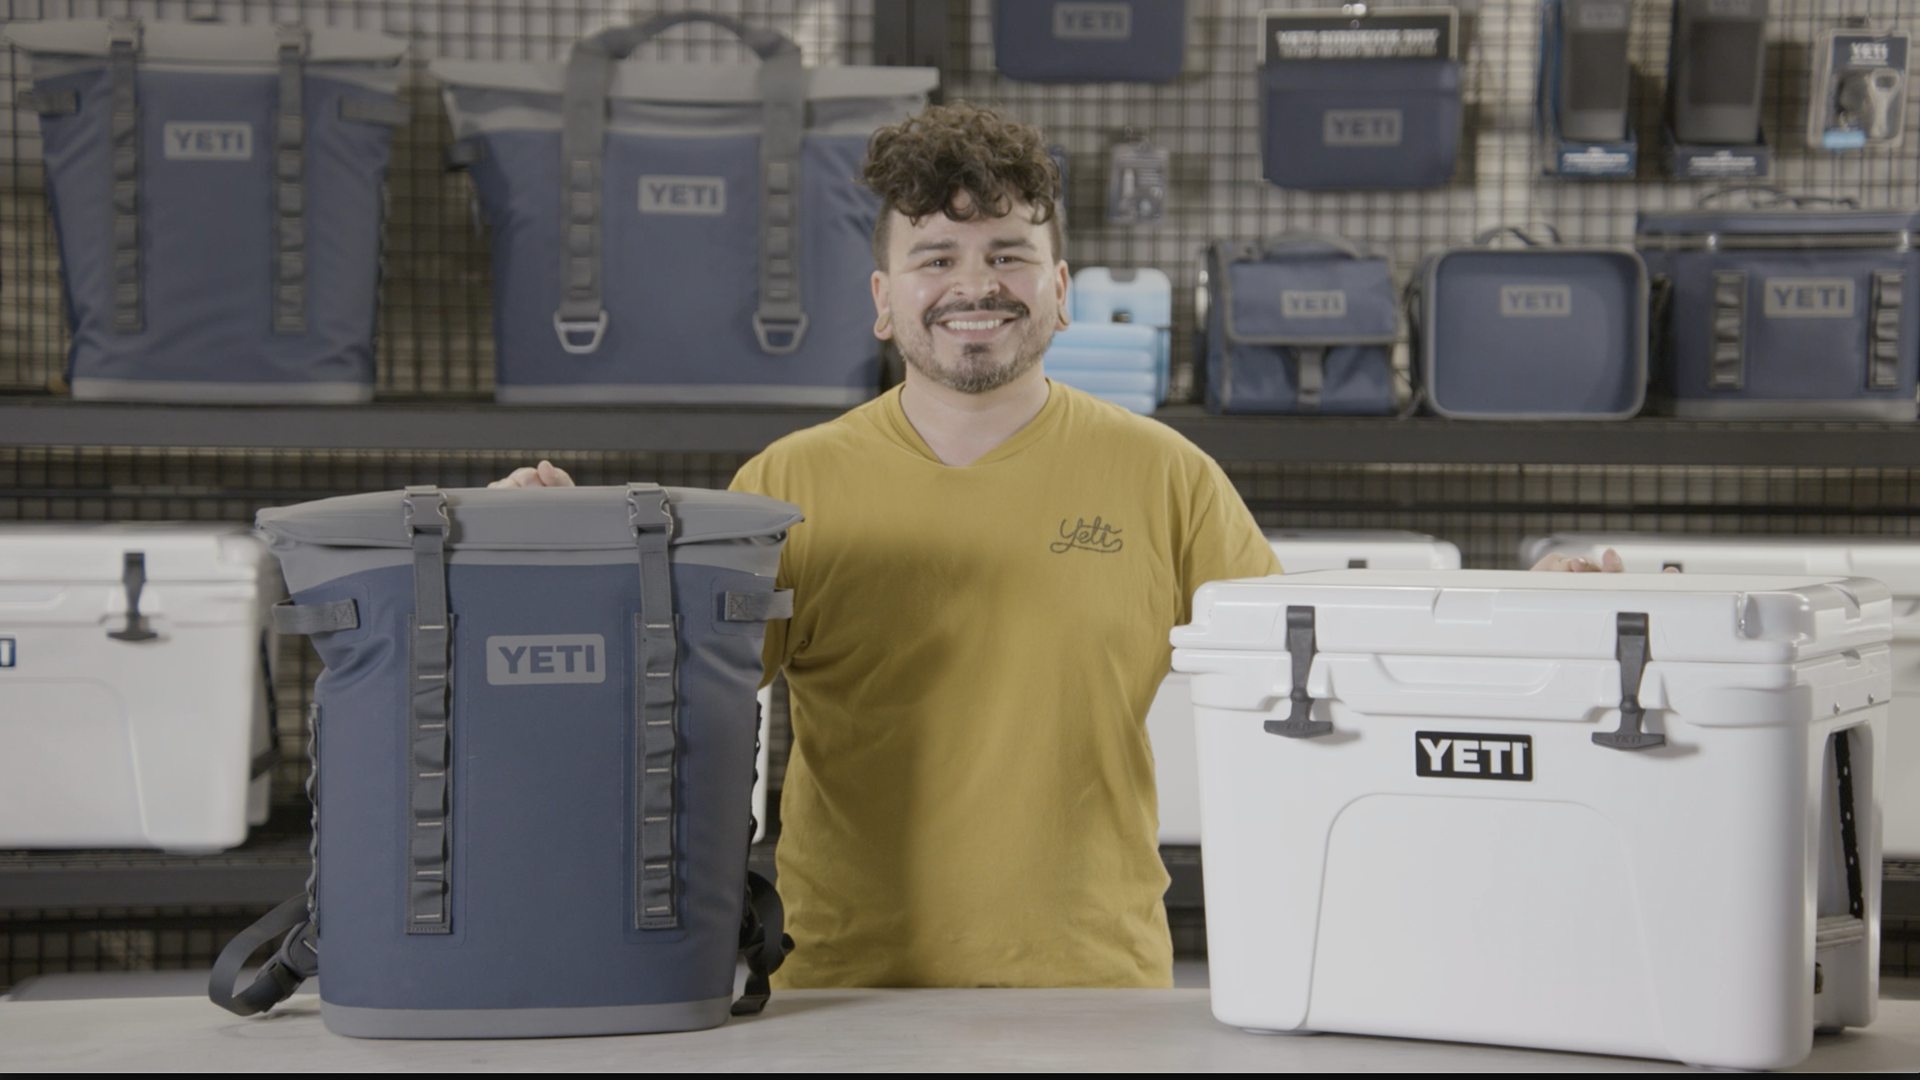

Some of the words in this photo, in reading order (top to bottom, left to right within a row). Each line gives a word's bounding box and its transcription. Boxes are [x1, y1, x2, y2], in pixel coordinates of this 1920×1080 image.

[1331, 116, 1396, 137] YETI
[172, 129, 244, 152] YETI
[647, 183, 718, 206] YETI
[1288, 296, 1340, 311] YETI
[1507, 291, 1563, 310] YETI
[1772, 285, 1846, 309] YETI
[1050, 516, 1123, 553] Yeti
[498, 645, 596, 674] YETI
